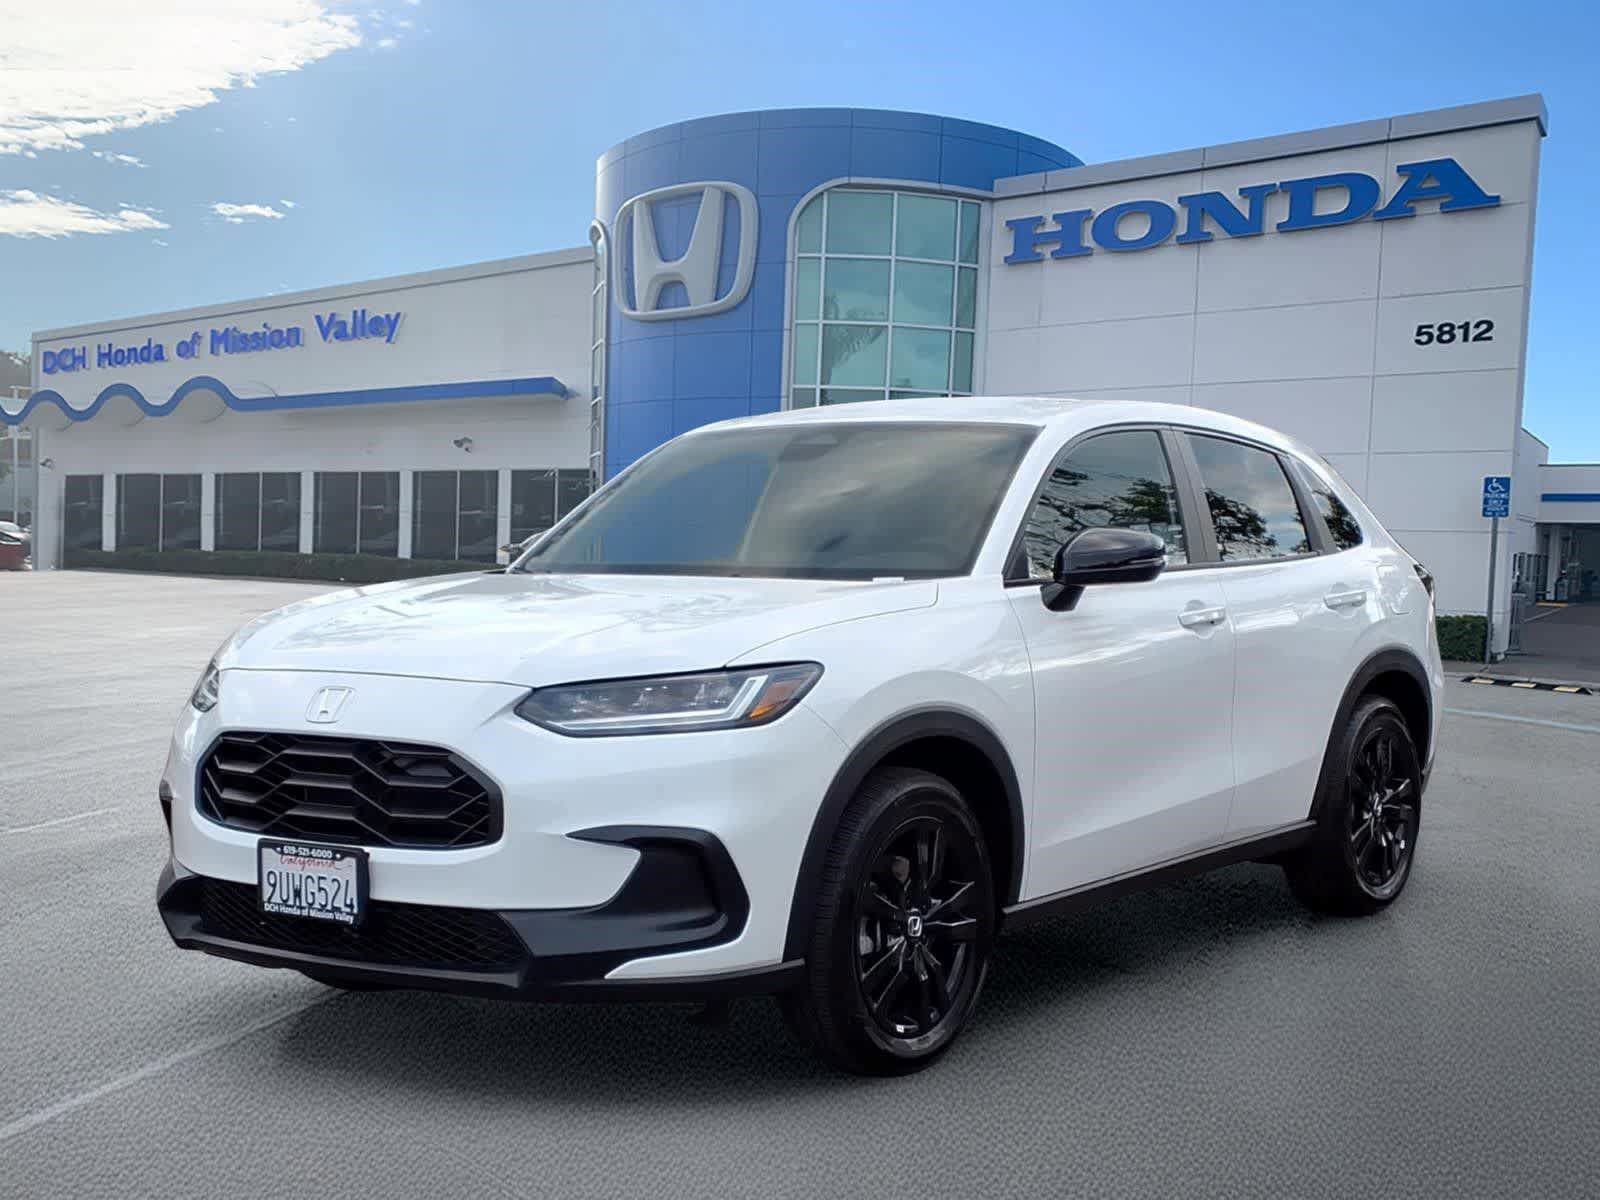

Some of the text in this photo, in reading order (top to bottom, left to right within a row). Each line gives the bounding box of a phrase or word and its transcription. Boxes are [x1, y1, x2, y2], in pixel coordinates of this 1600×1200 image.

[1004, 158, 1501, 265] HONDA
[42, 309, 402, 375] DCH Honda of Mission Valley
[1414, 319, 1494, 346] 5812
[267, 870, 355, 913] 9UWG524
